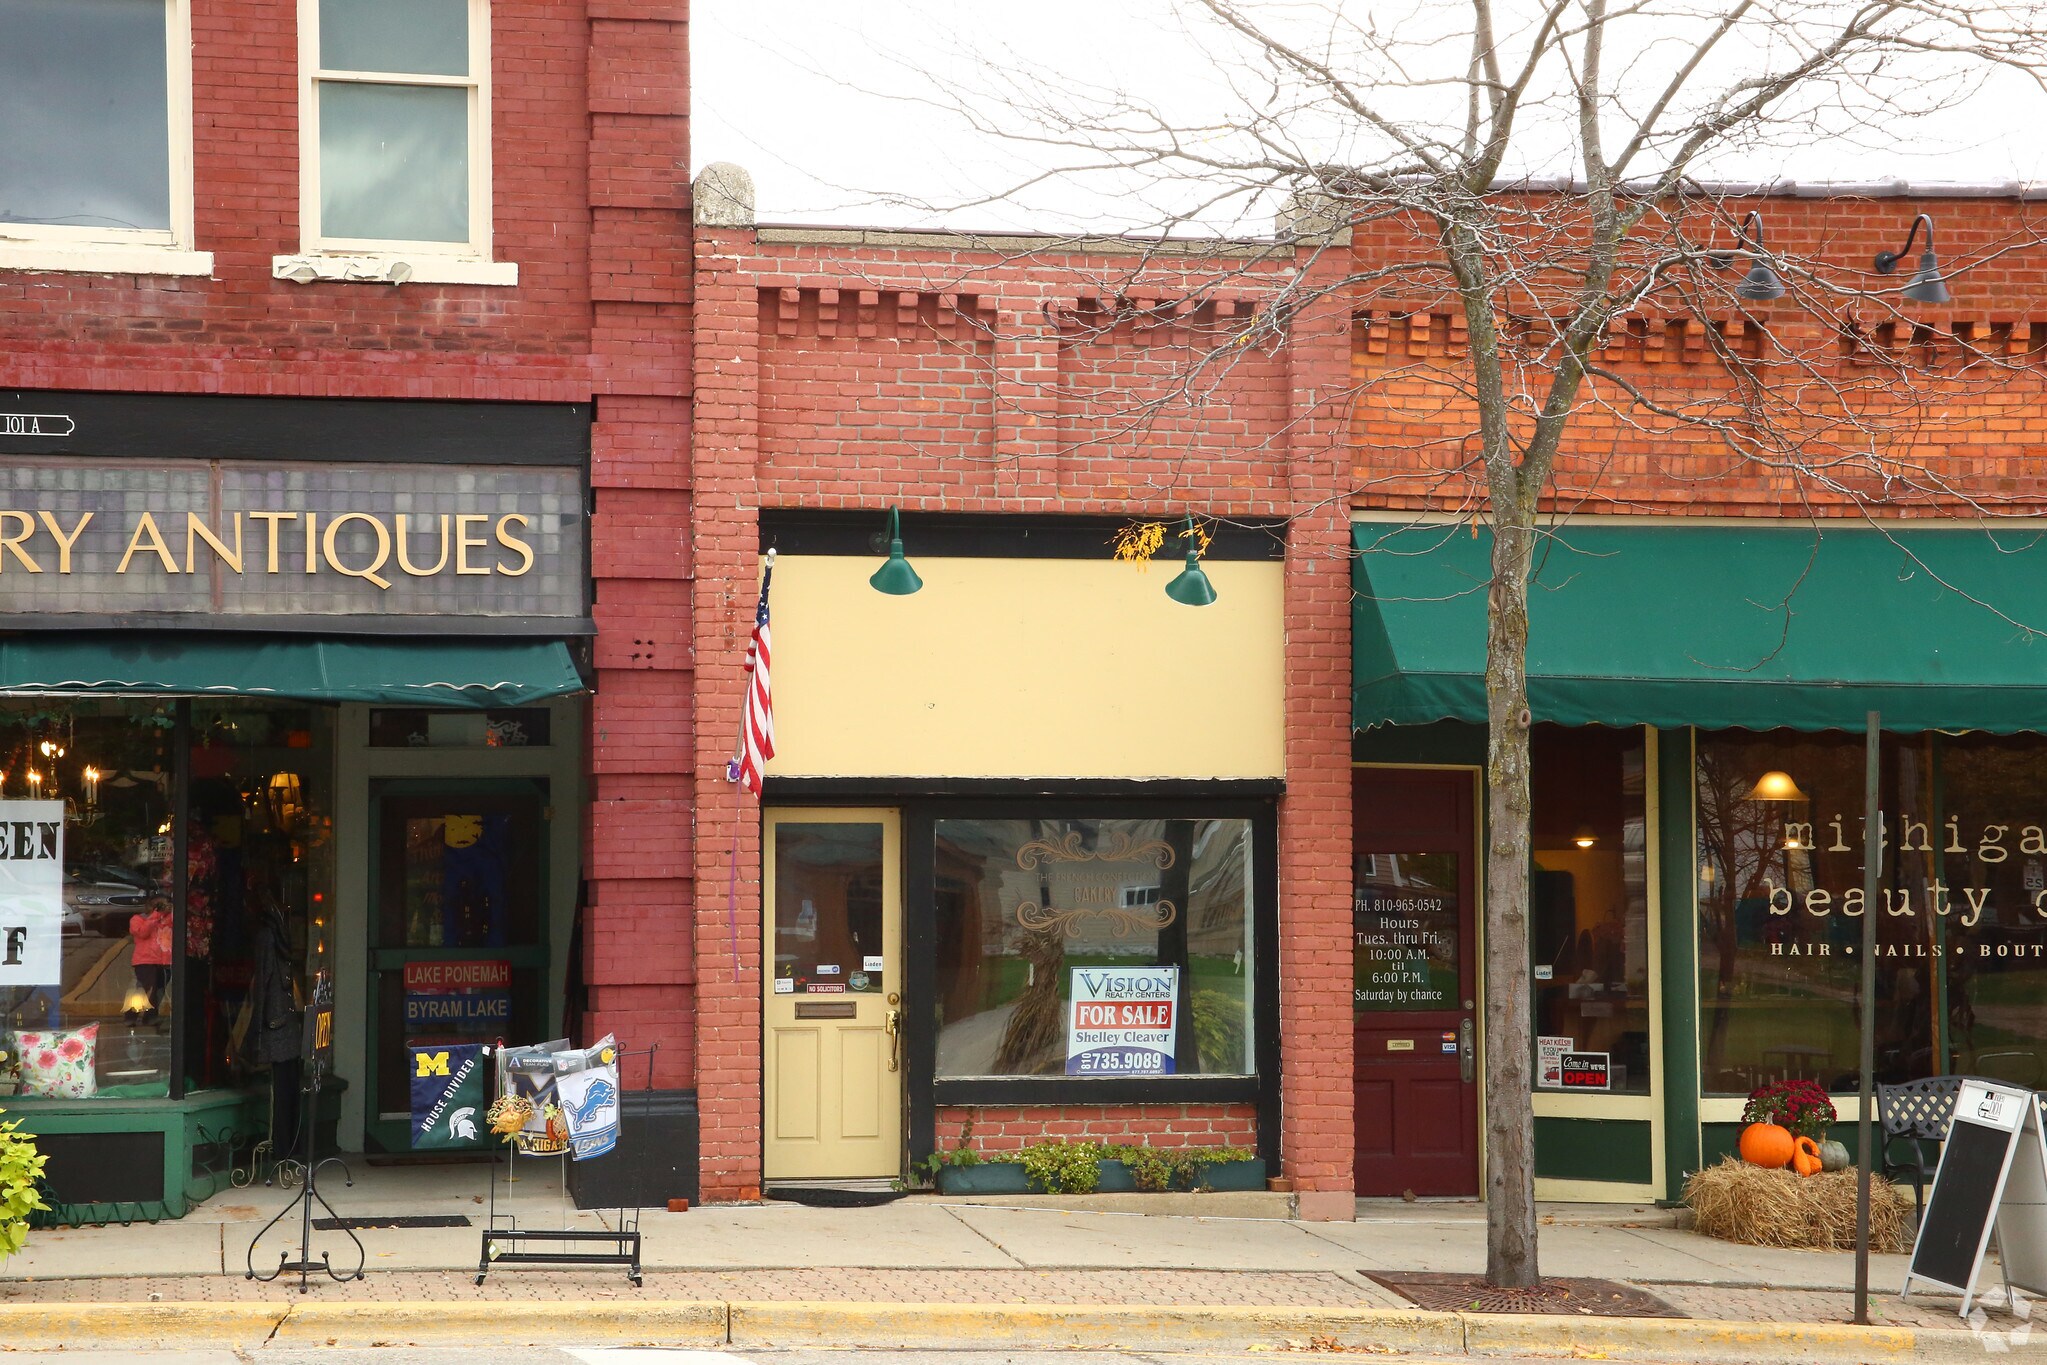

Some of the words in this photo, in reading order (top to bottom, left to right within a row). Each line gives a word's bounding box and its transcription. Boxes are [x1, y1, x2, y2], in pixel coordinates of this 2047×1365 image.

[6, 416, 25, 433] 101
[31, 417, 41, 433] A
[0, 511, 94, 573] RY
[116, 512, 534, 589] ANTIQUES
[1781, 814, 2047, 862] mihiga
[1355, 899, 1371, 912] PH.
[1374, 899, 1442, 912] 810-965-0542
[1763, 878, 1992, 927] beauty
[1380, 918, 1419, 929] Hours
[1356, 932, 1389, 945] Tues.
[1393, 932, 1418, 944] thru
[1422, 931, 1441, 944] Fri.
[1370, 949, 1402, 960] 10:00
[1406, 949, 1430, 960] A.M.
[1771, 943, 1831, 956] HAIR
[1979, 944, 2043, 956] BOUT
[1392, 962, 1405, 971] til
[407, 967, 441, 984] LAKE
[445, 966, 508, 983] PONEMAH
[1372, 972, 1398, 983] 6:00
[1402, 972, 1424, 983] P.M.
[1079, 973, 1174, 998] VISION
[1355, 989, 1394, 1003] Saturday
[1397, 989, 1408, 1003] by
[1410, 989, 1442, 1000] chance
[408, 1001, 462, 1018] BYRAM
[467, 1000, 507, 1017] LAKE
[1079, 1005, 1117, 1025] FOR
[1121, 1005, 1168, 1025] SALE
[1076, 1031, 1121, 1045] Shelley
[1124, 1031, 1169, 1043] Cleaver
[415, 1051, 451, 1077] M
[1081, 1053, 1091, 1070] 810
[1092, 1053, 1161, 1069] 735.9089
[1563, 1056, 1581, 1068] Come
[1582, 1060, 1589, 1068] in
[1590, 1063, 1606, 1071] WE'RE
[1564, 1071, 1606, 1085] OPEN
[420, 1099, 448, 1132] HOUSE
[443, 1059, 475, 1099] DIVIDED
